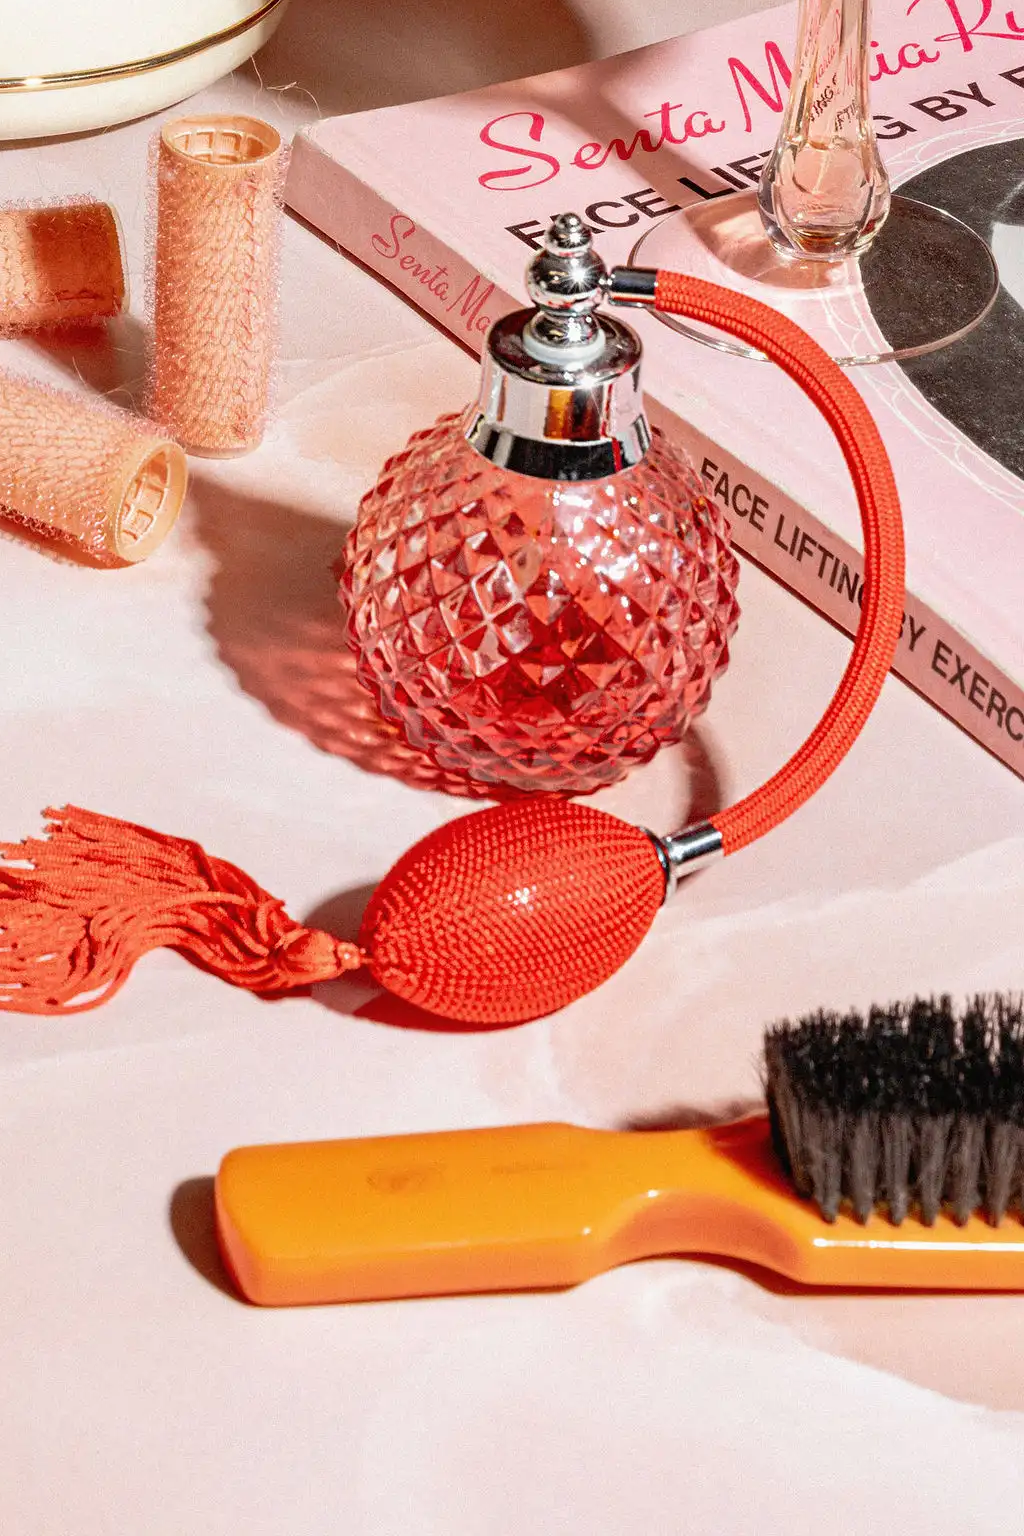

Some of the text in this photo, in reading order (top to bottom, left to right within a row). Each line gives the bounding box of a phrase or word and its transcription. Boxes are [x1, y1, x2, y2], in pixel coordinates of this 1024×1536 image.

[478, 101, 726, 191] Senta
[727, 39, 940, 133] Mia
[504, 81, 996, 252] FCE LIFG BY
[371, 214, 449, 301] Senta
[701, 457, 770, 533] FACE
